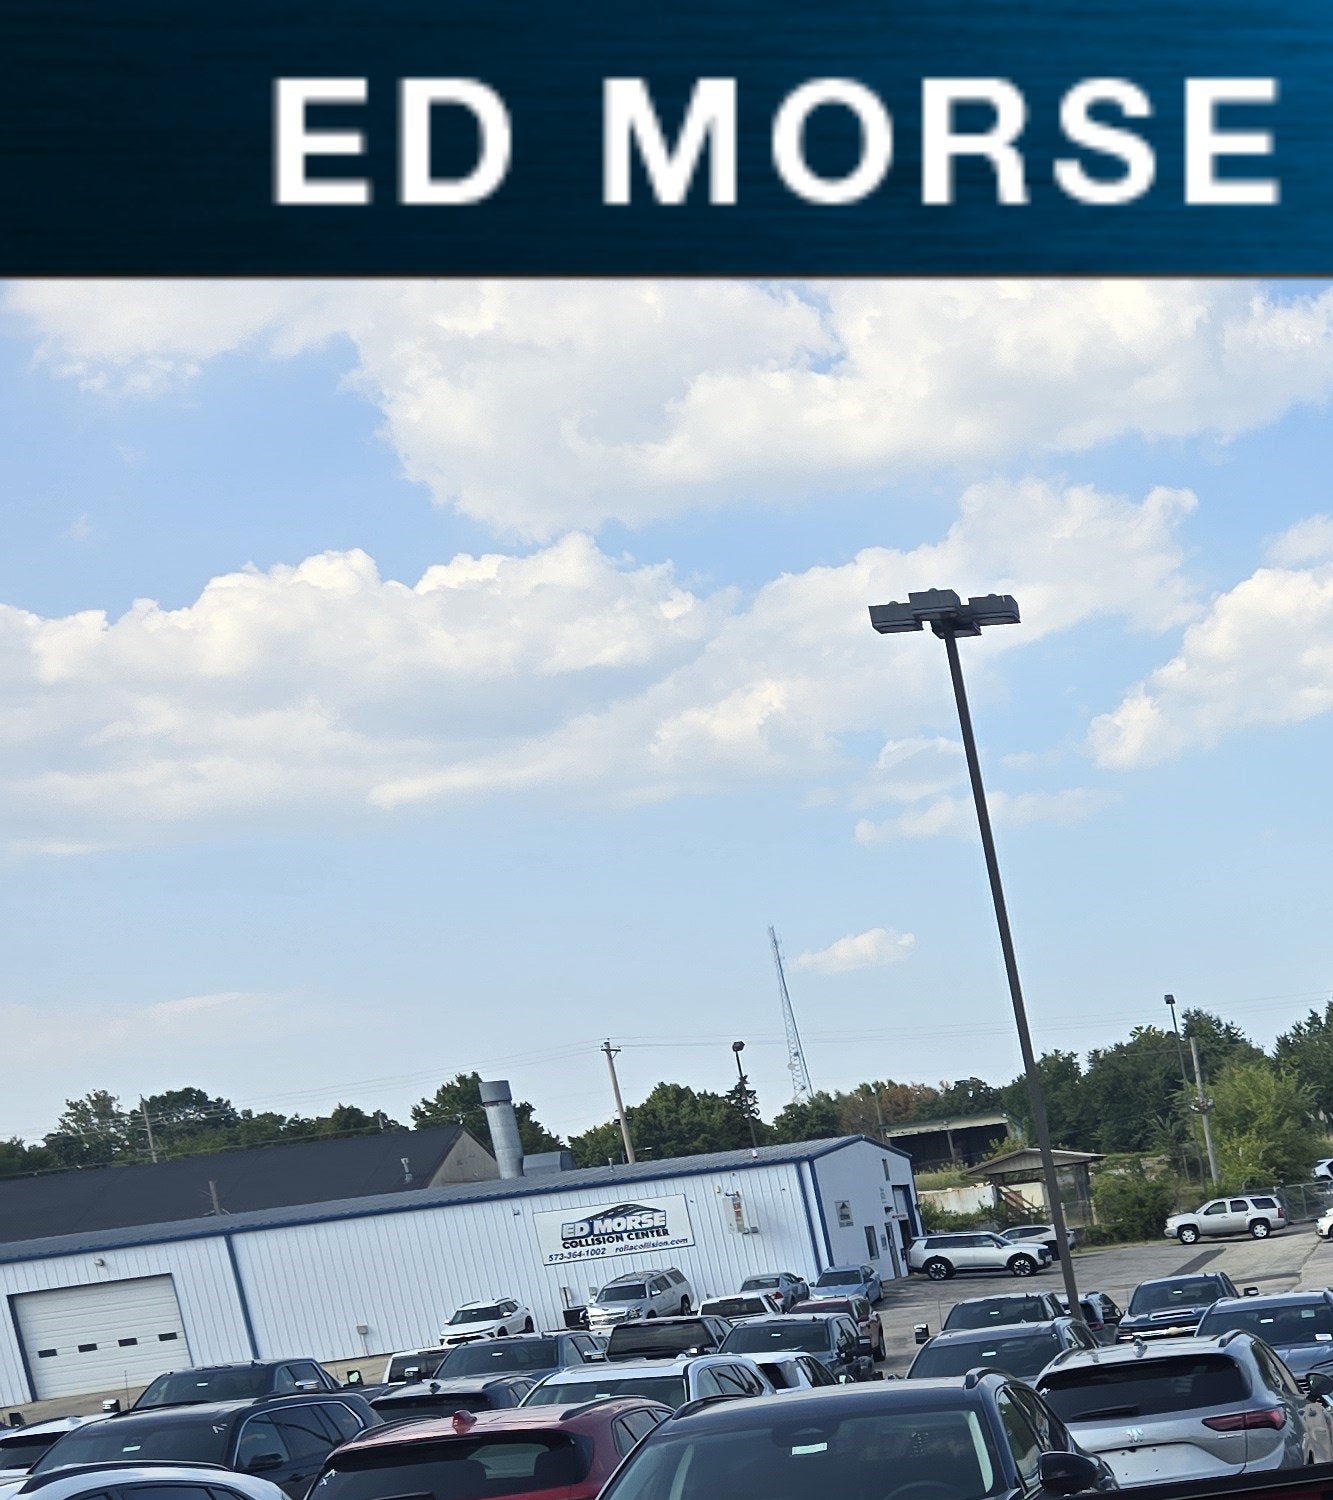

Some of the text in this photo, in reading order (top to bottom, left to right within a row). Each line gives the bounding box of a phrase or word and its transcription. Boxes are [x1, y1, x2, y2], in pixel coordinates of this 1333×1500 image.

[561, 1209, 667, 1241] ED MORSE
[562, 1228, 670, 1250] COLLISION CENTER
[548, 1247, 607, 1262] 573-364-1002
